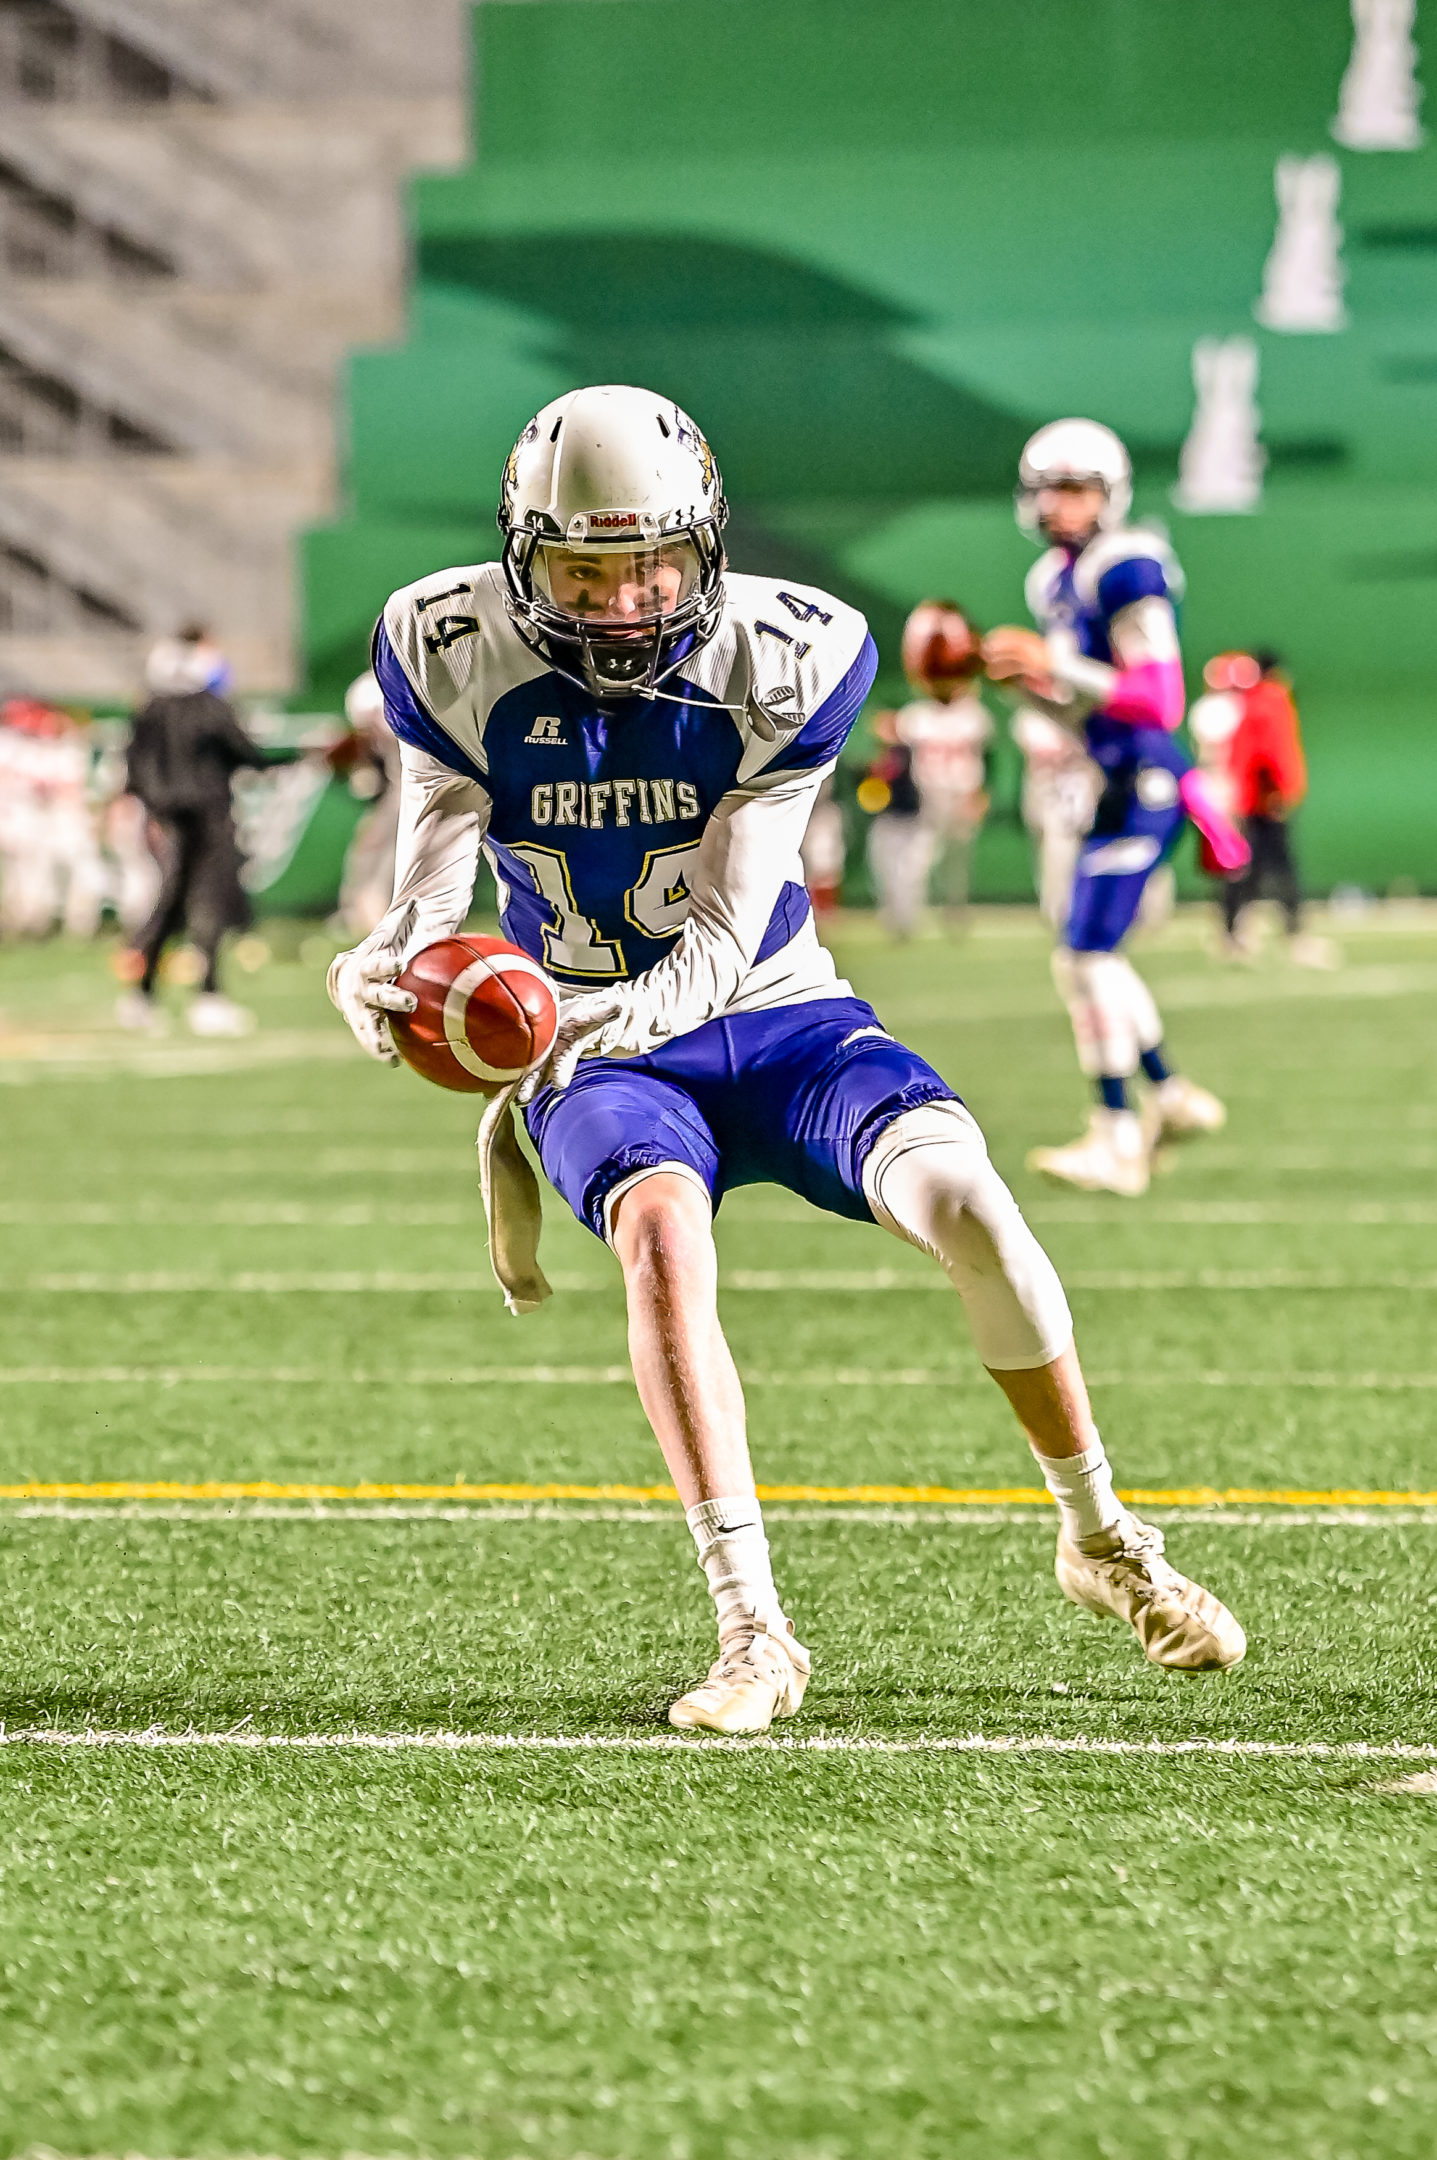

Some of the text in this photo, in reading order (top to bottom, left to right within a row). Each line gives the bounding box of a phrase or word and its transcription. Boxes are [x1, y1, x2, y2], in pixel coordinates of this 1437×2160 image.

[590, 513, 637, 528] Riddell
[414, 582, 481, 656] 14
[754, 591, 834, 662] 14
[524, 736, 568, 745] RUSSELL
[531, 778, 700, 830] GRIFFINS
